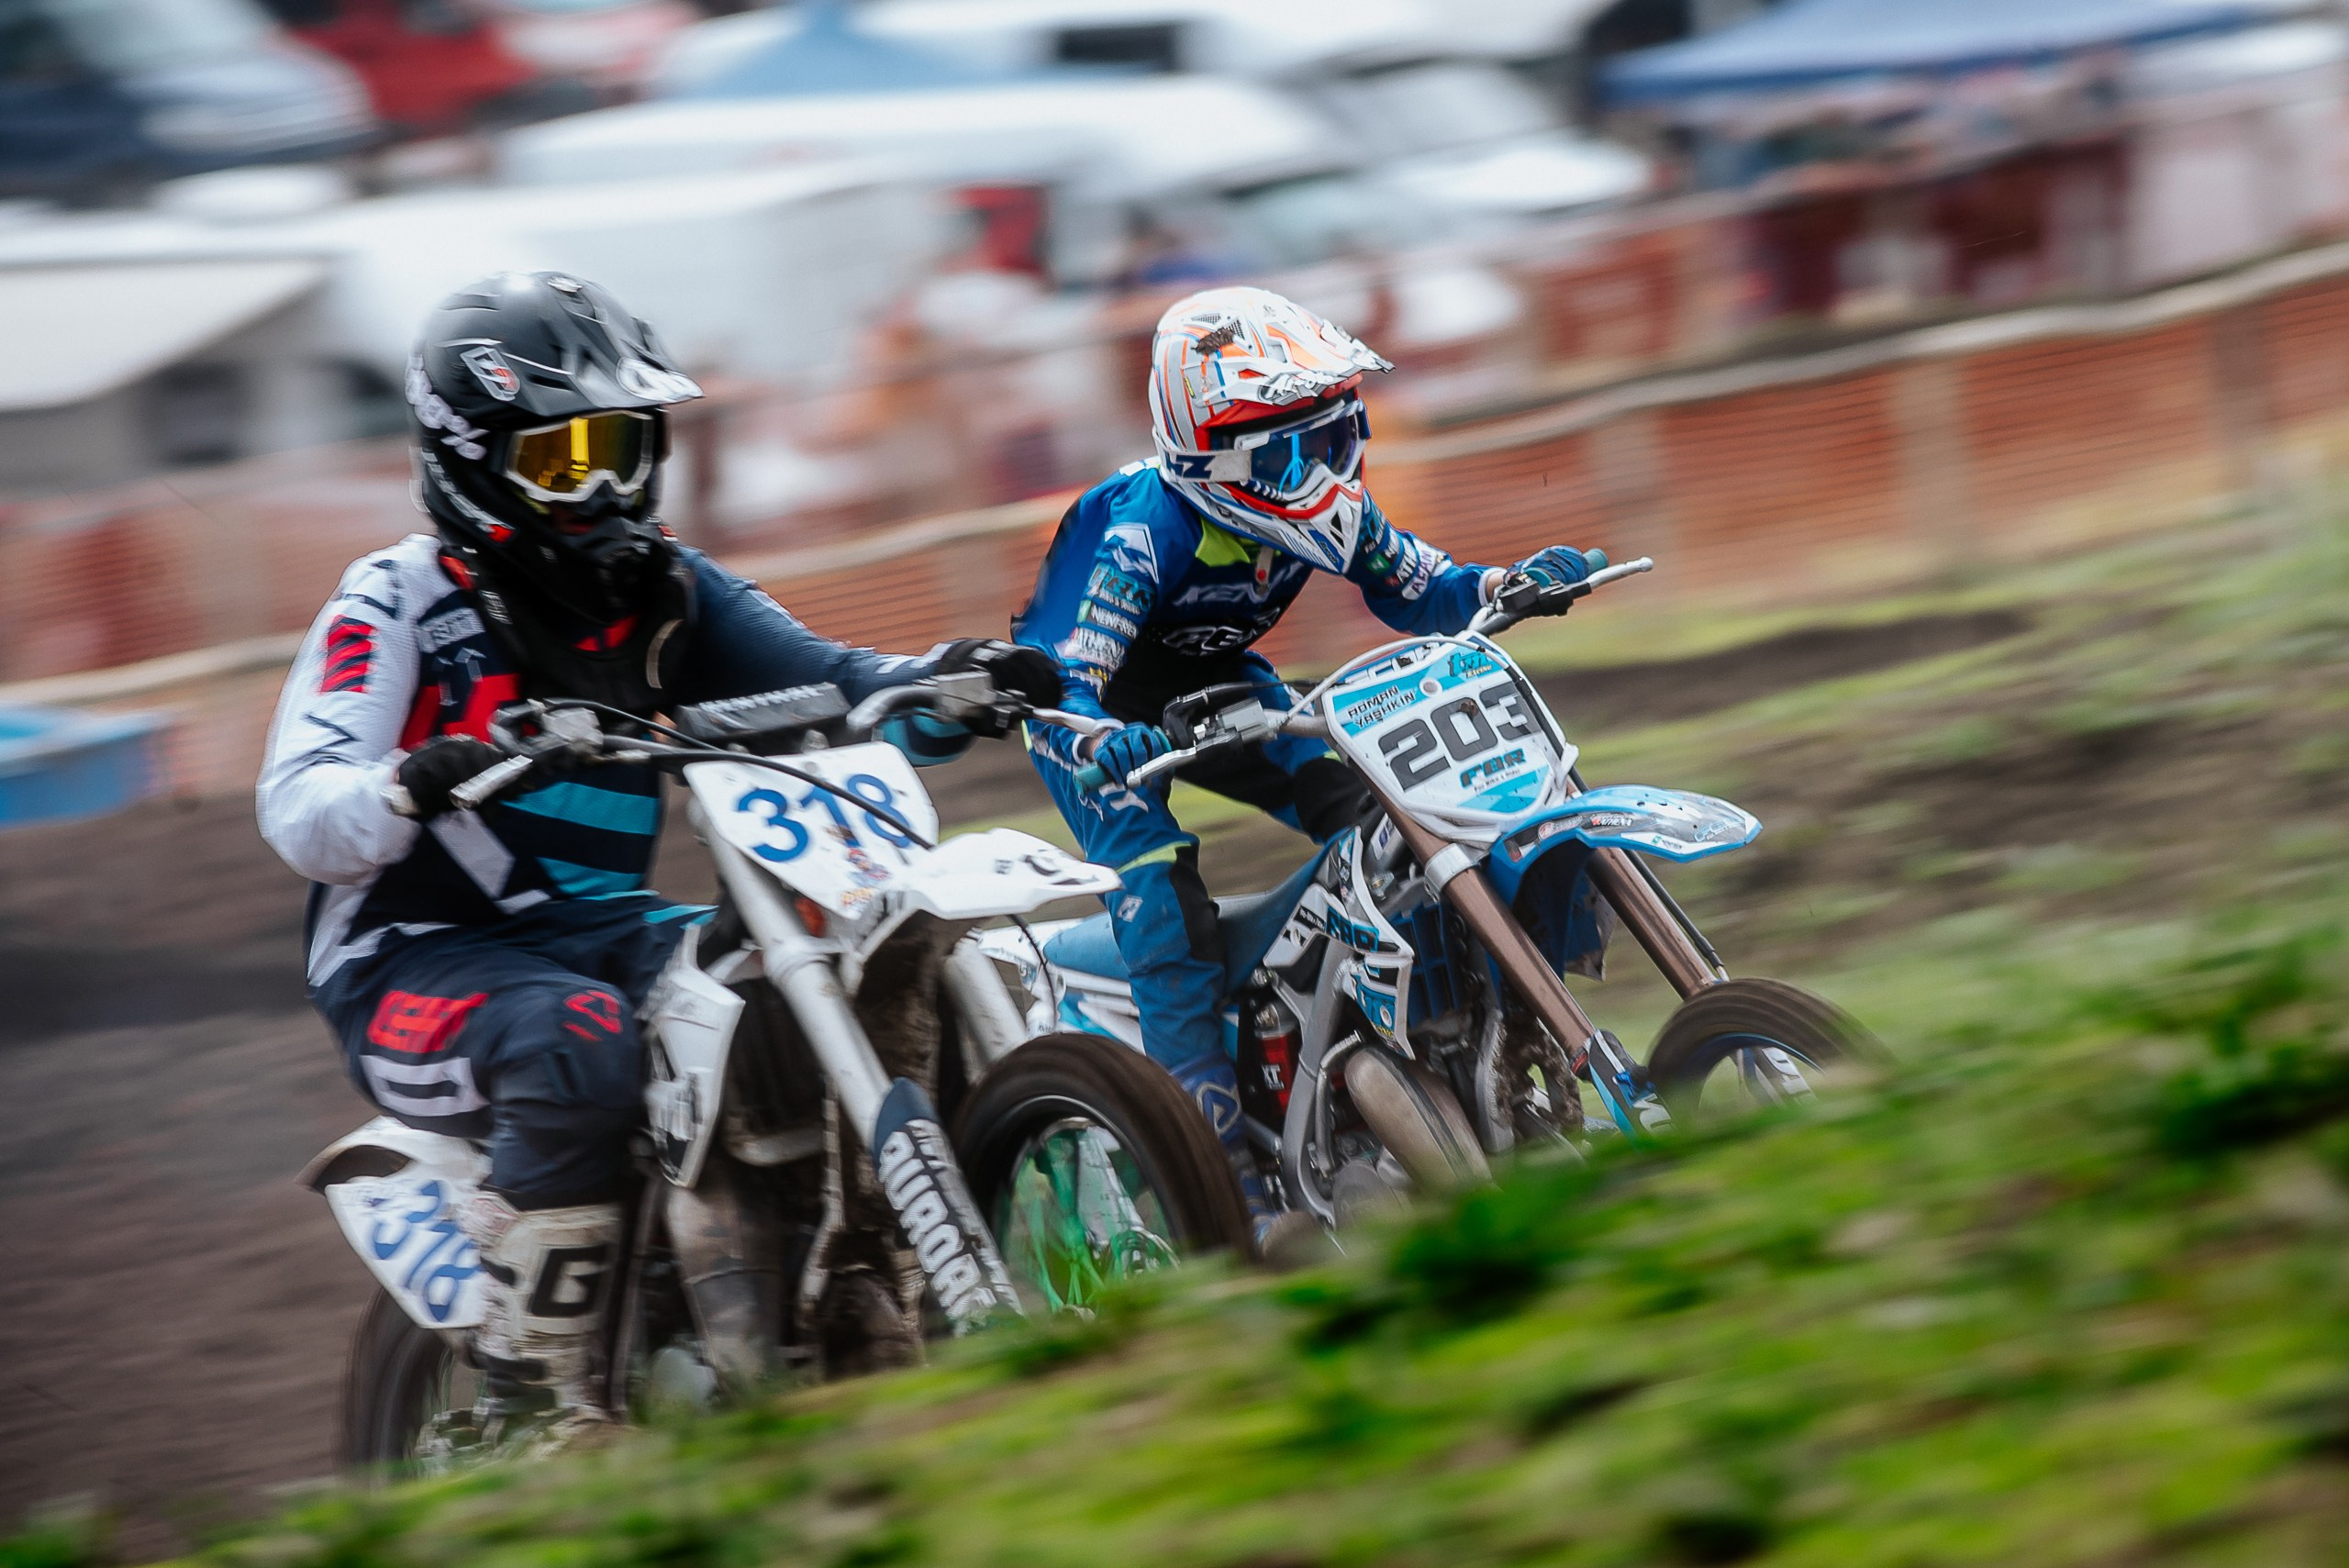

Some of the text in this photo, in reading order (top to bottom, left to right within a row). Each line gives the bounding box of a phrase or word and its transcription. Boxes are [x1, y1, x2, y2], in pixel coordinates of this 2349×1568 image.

[1347, 684, 1399, 718] ROMAN
[1355, 691, 1415, 728] YASHKIN
[1378, 681, 1541, 792] 203
[737, 774, 914, 862] 318
